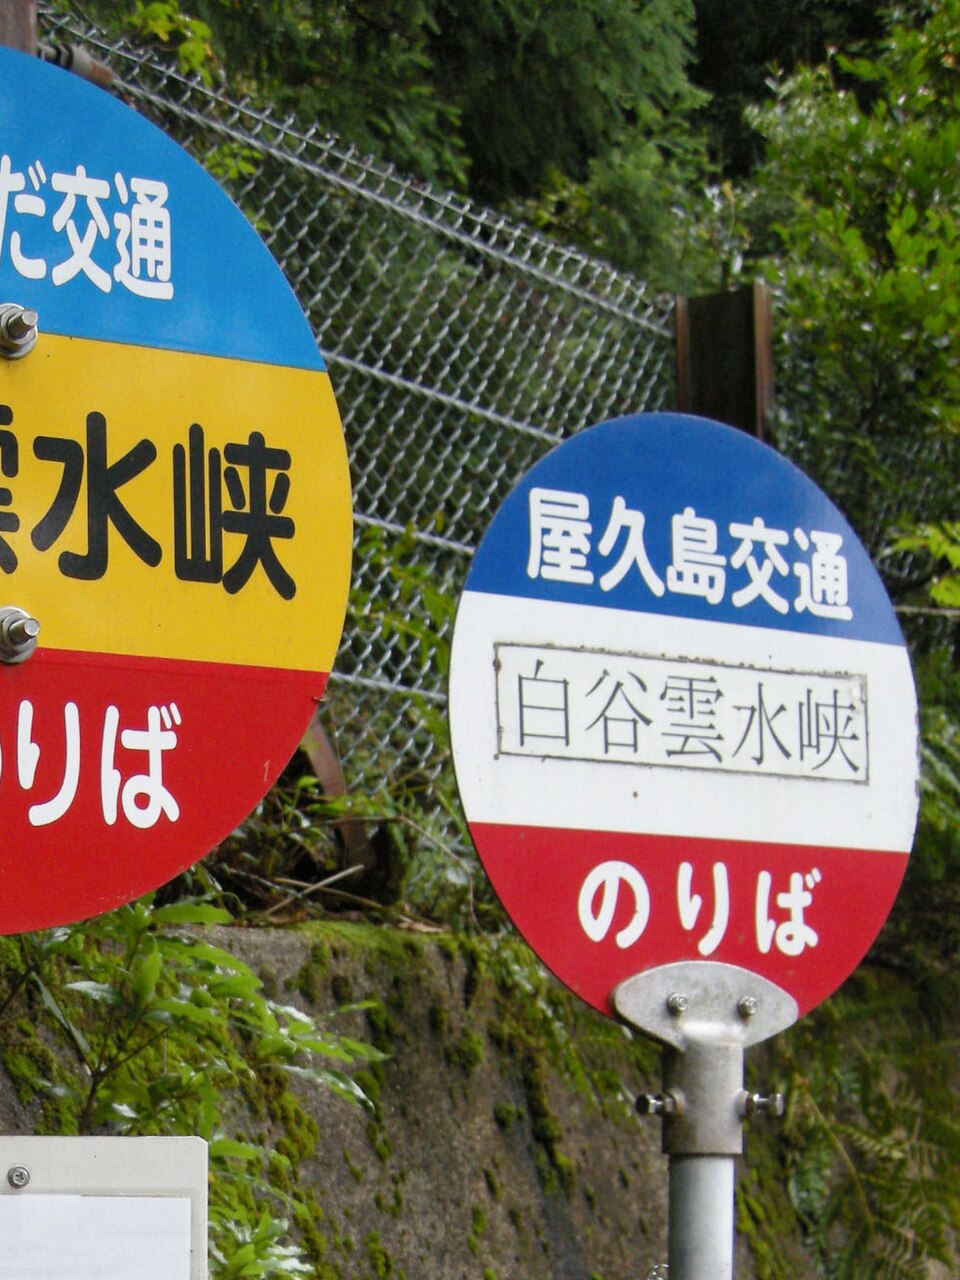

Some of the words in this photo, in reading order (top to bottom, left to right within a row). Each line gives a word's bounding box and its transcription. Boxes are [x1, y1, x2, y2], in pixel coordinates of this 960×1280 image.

[526, 487, 854, 621] 屋久島交通
[517, 660, 861, 775] 白谷雲水峡
[578, 860, 822, 957] のりば
